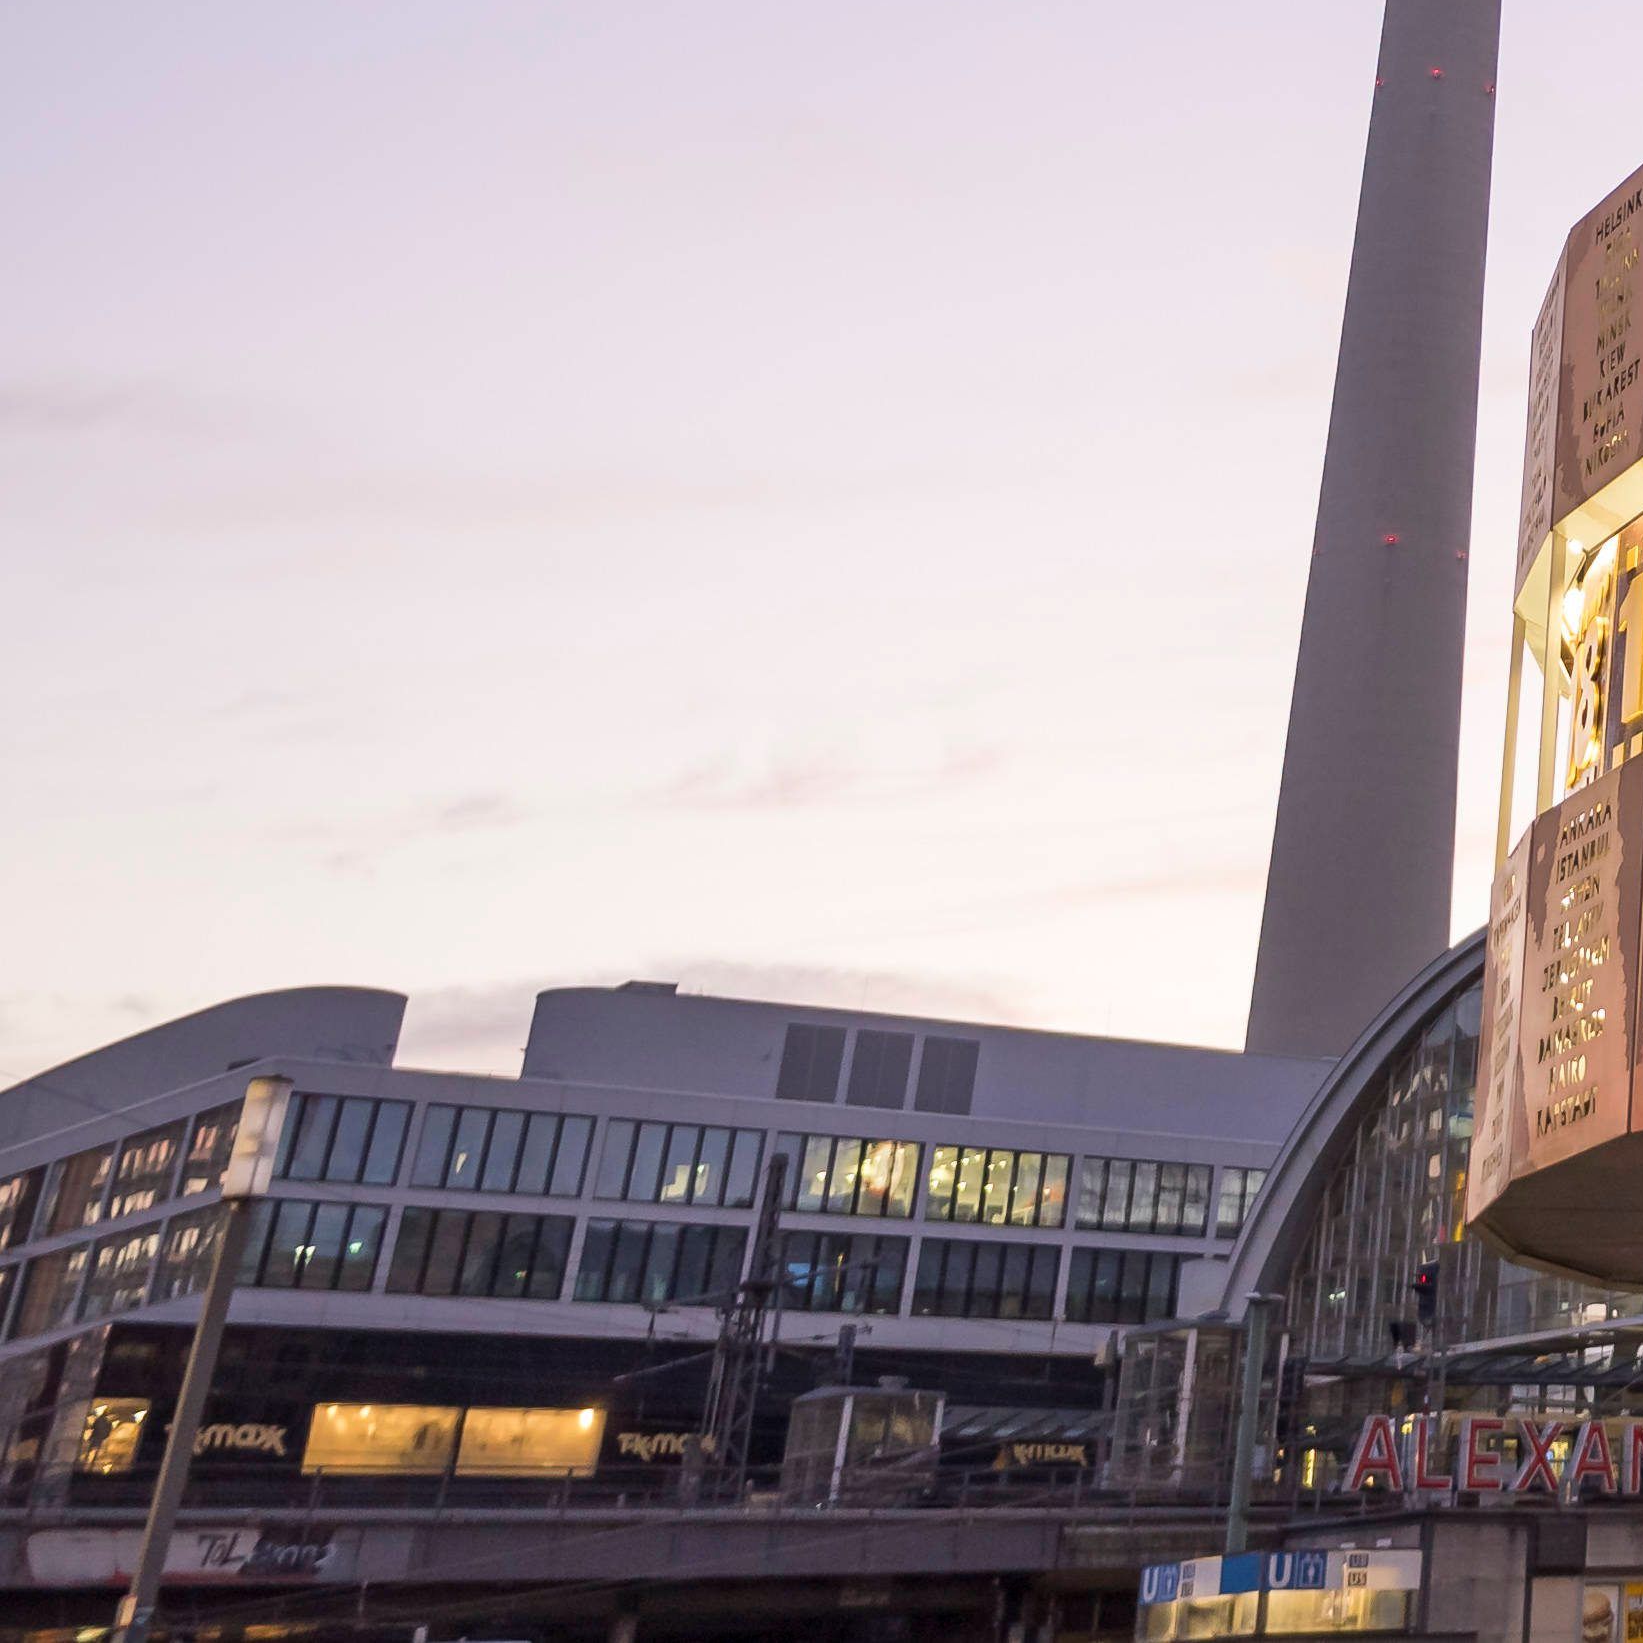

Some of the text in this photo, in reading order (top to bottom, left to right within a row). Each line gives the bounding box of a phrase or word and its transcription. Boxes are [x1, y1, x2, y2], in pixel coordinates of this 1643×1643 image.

[1596, 312, 1632, 356] MINSK
[1600, 341, 1626, 379] KIEW
[1583, 359, 1641, 423] BUKAREST
[1560, 798, 1612, 850] ANKARA
[1556, 832, 1611, 885] ISTANBUL
[1548, 1053, 1587, 1096] KAIRO
[1142, 1566, 1159, 1601] U
[1269, 1553, 1293, 1589] U
